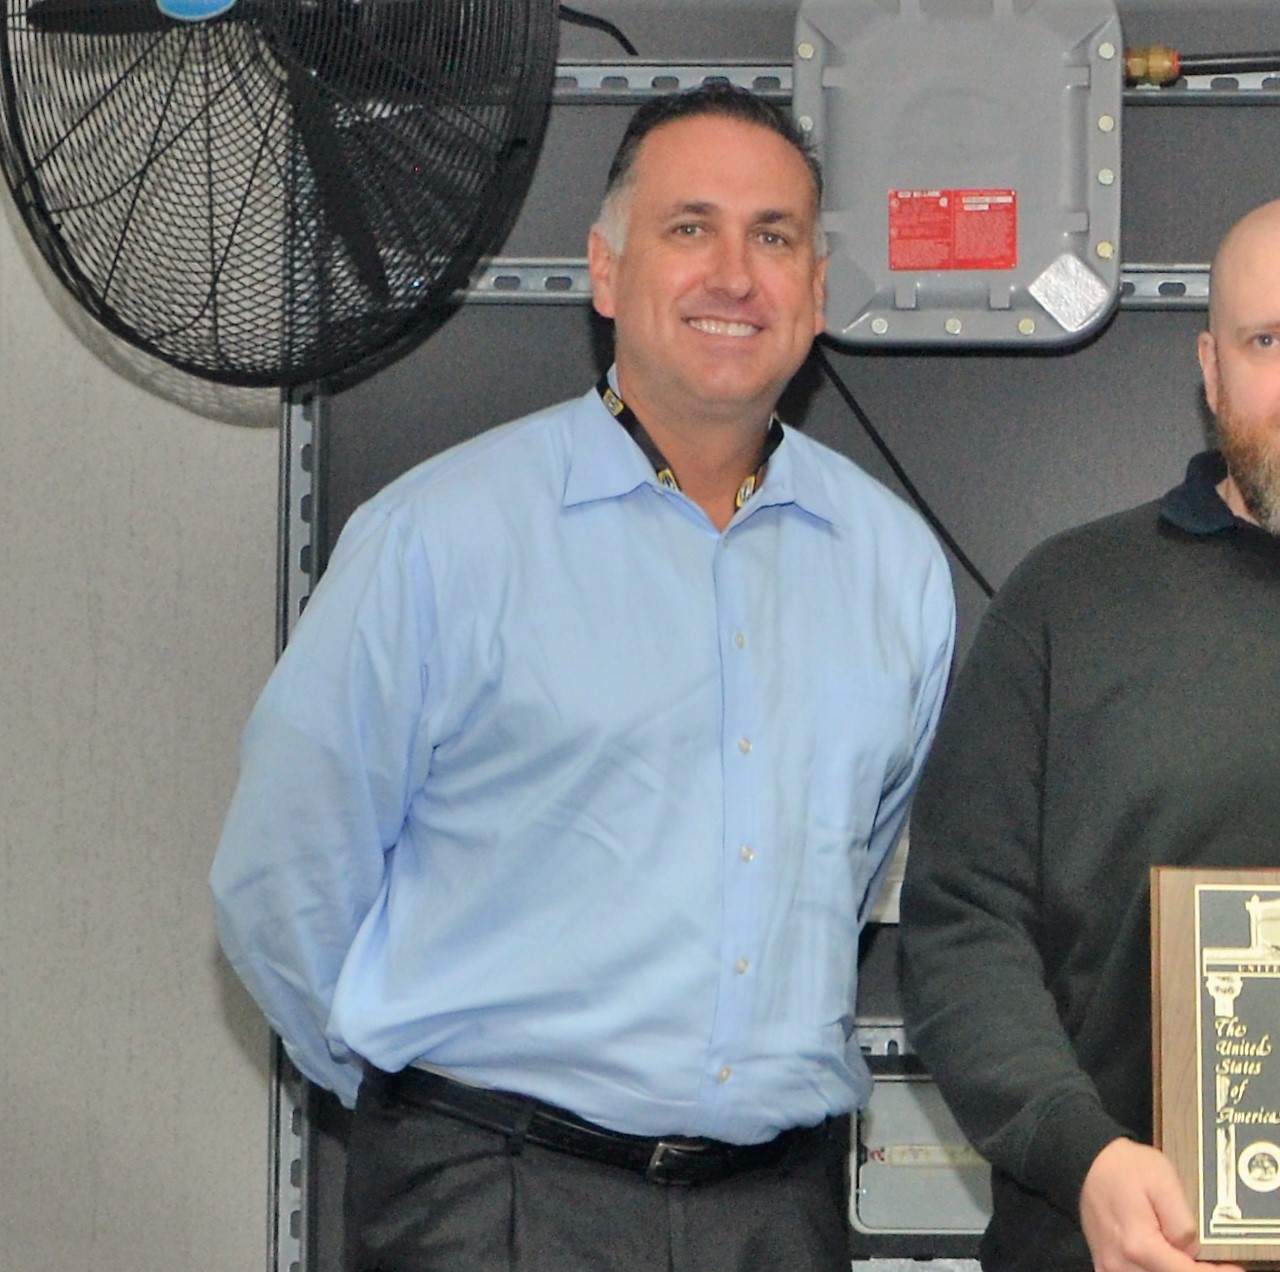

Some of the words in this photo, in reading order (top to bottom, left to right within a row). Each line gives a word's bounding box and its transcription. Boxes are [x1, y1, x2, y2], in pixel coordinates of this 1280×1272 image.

[1215, 1016, 1247, 1037] The
[1216, 1034, 1271, 1056] United
[1216, 1058, 1261, 1075] States
[1230, 1078, 1249, 1105] of
